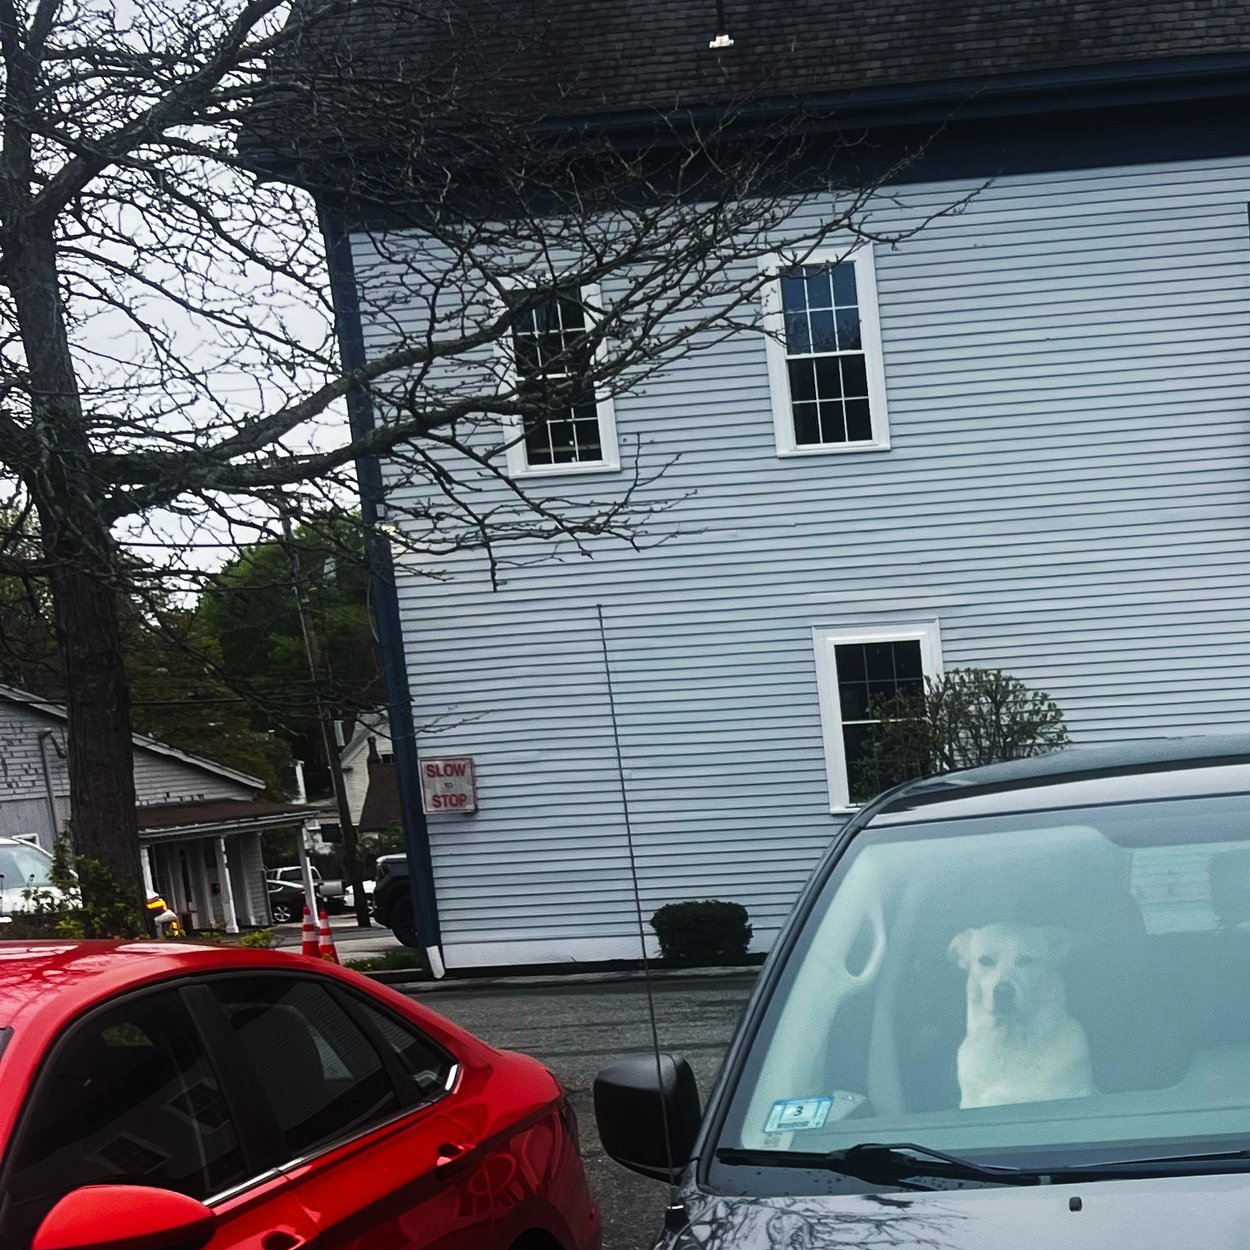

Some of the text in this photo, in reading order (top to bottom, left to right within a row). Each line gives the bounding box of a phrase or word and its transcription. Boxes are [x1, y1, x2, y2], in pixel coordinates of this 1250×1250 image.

[426, 763, 466, 778] SLOW
[432, 793, 467, 808] STOP
[793, 1105, 804, 1117] 3
